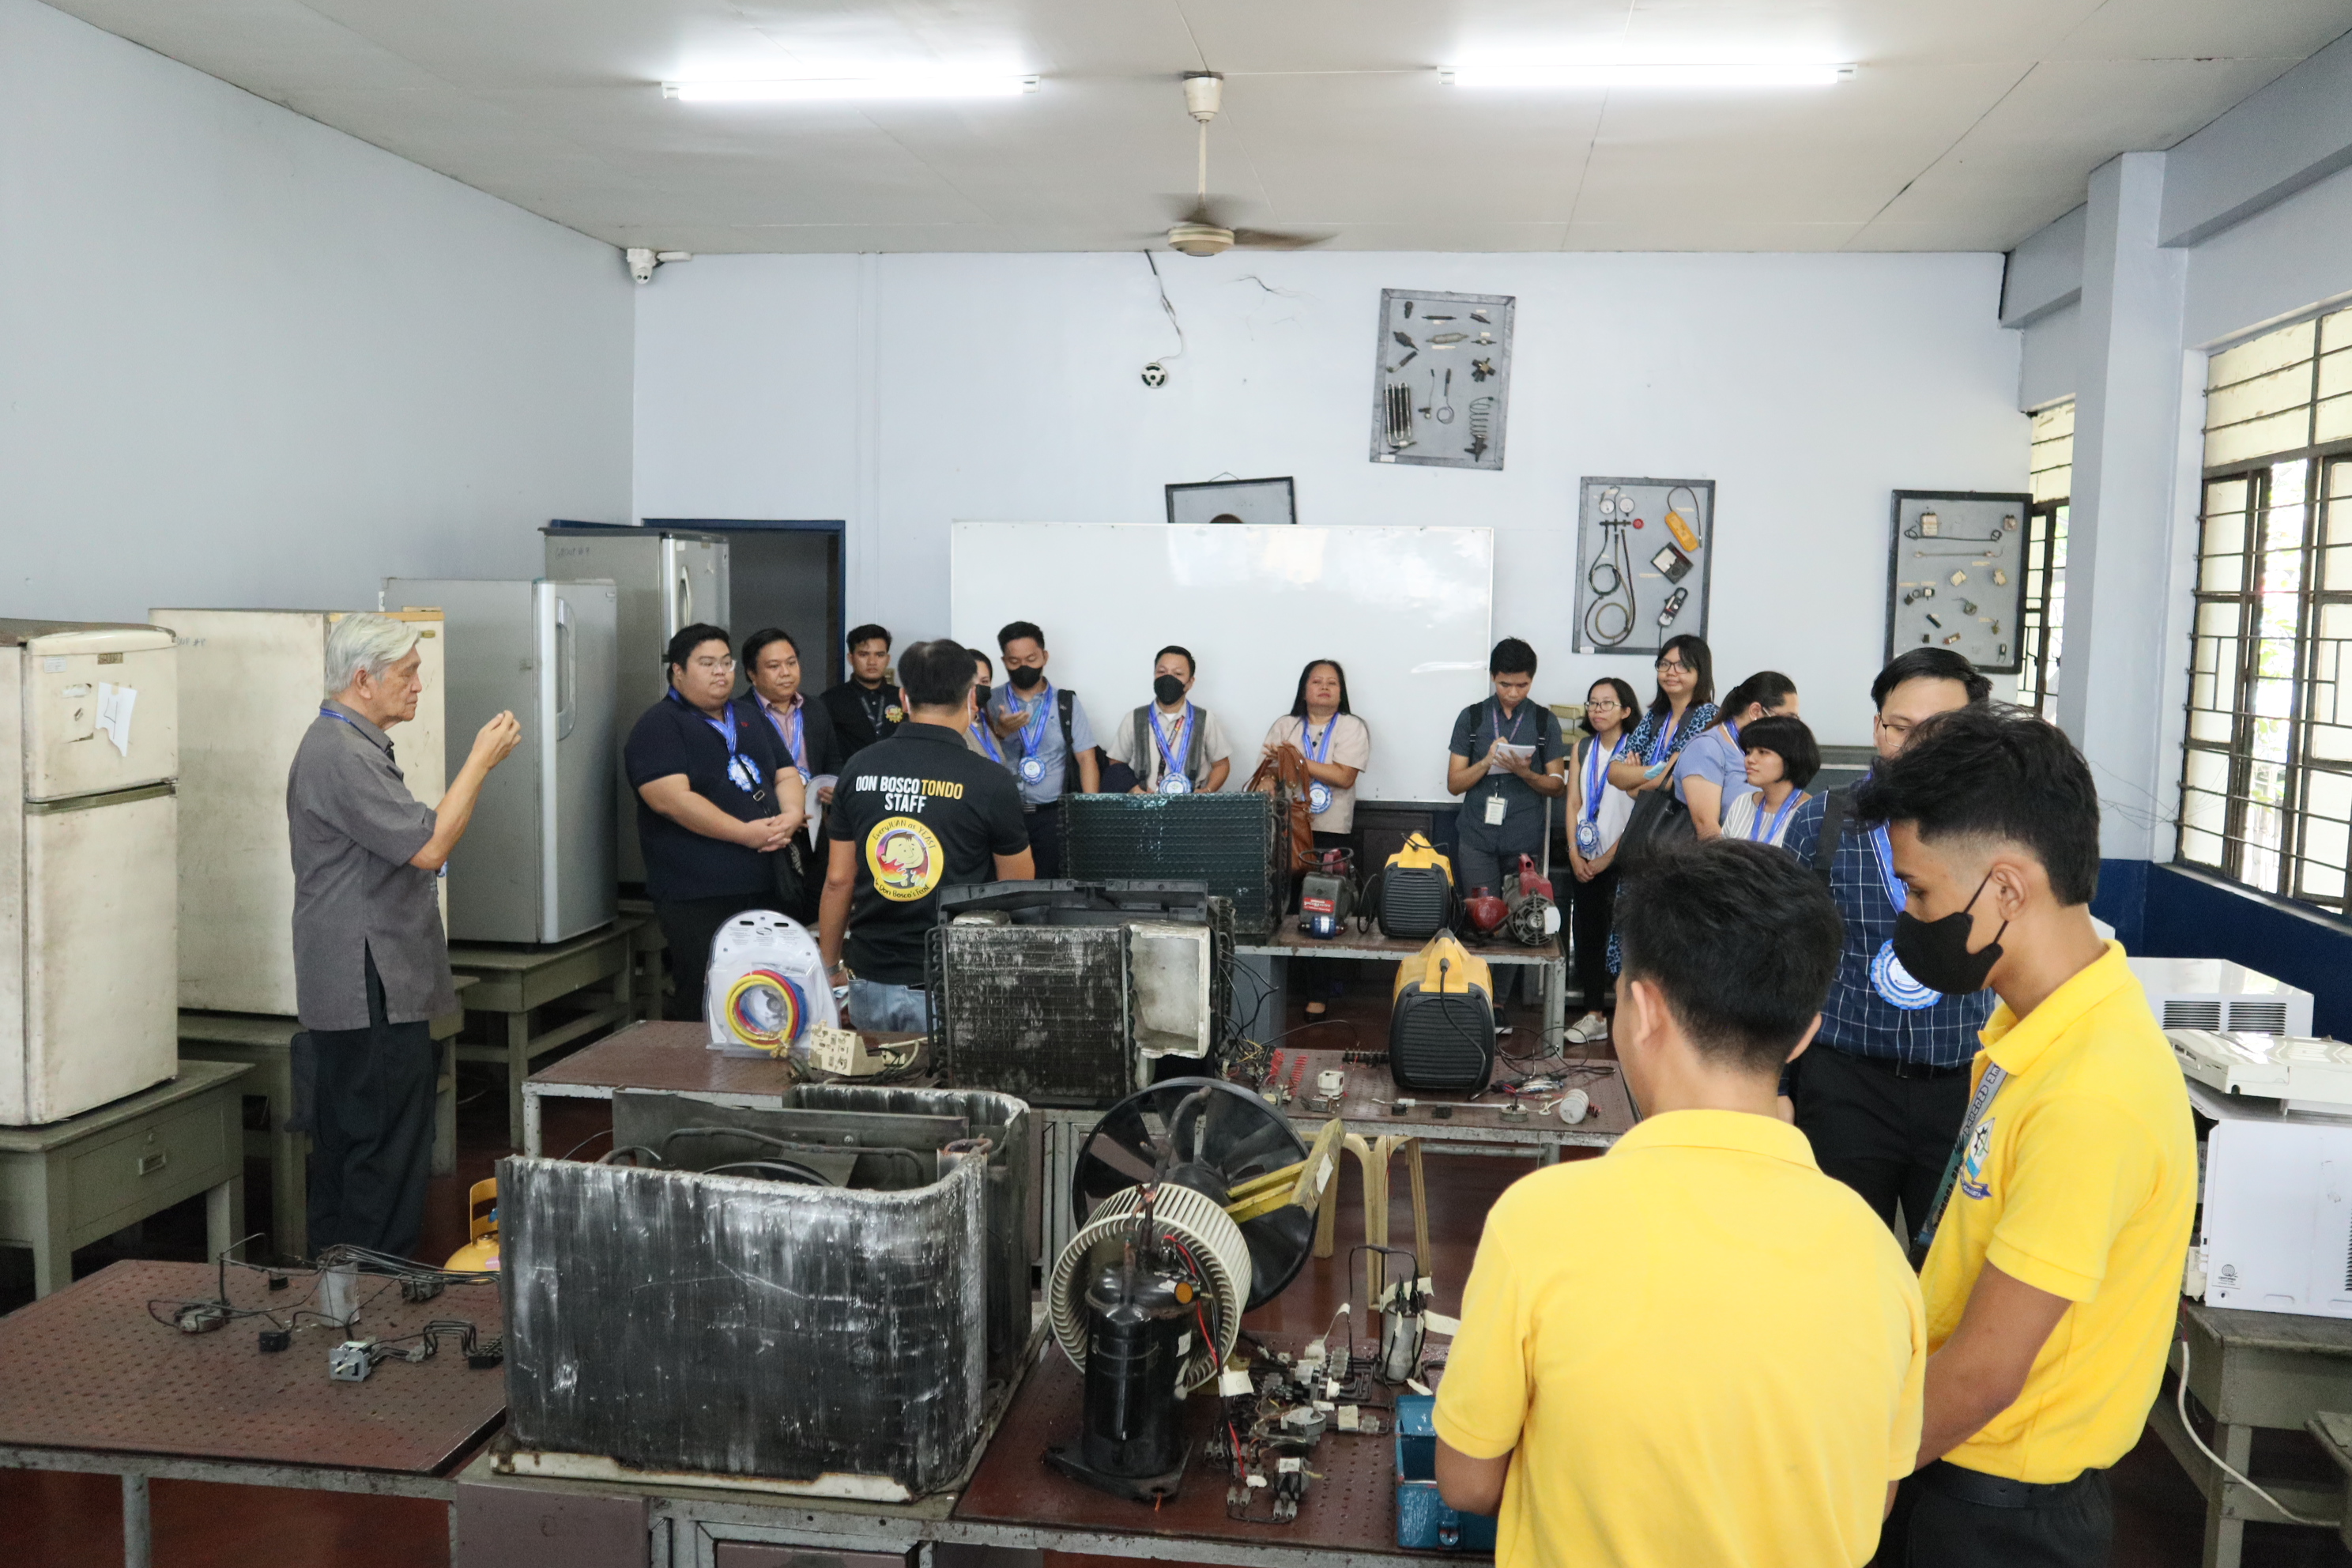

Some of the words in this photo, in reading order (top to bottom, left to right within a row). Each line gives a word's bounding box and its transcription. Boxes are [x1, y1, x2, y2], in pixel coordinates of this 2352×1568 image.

[103, 696, 119, 740] 4
[855, 775, 878, 792] DON
[880, 775, 921, 795] BOSCO
[921, 778, 963, 800] TONDO
[884, 793, 927, 813] STAFF
[872, 820, 906, 840] EveryJUAN
[918, 826, 936, 849] YEAST
[879, 884, 891, 897] Don
[892, 890, 916, 899] Bosco's
[916, 884, 930, 896] Feast
[1985, 1063, 2001, 1084] ER
